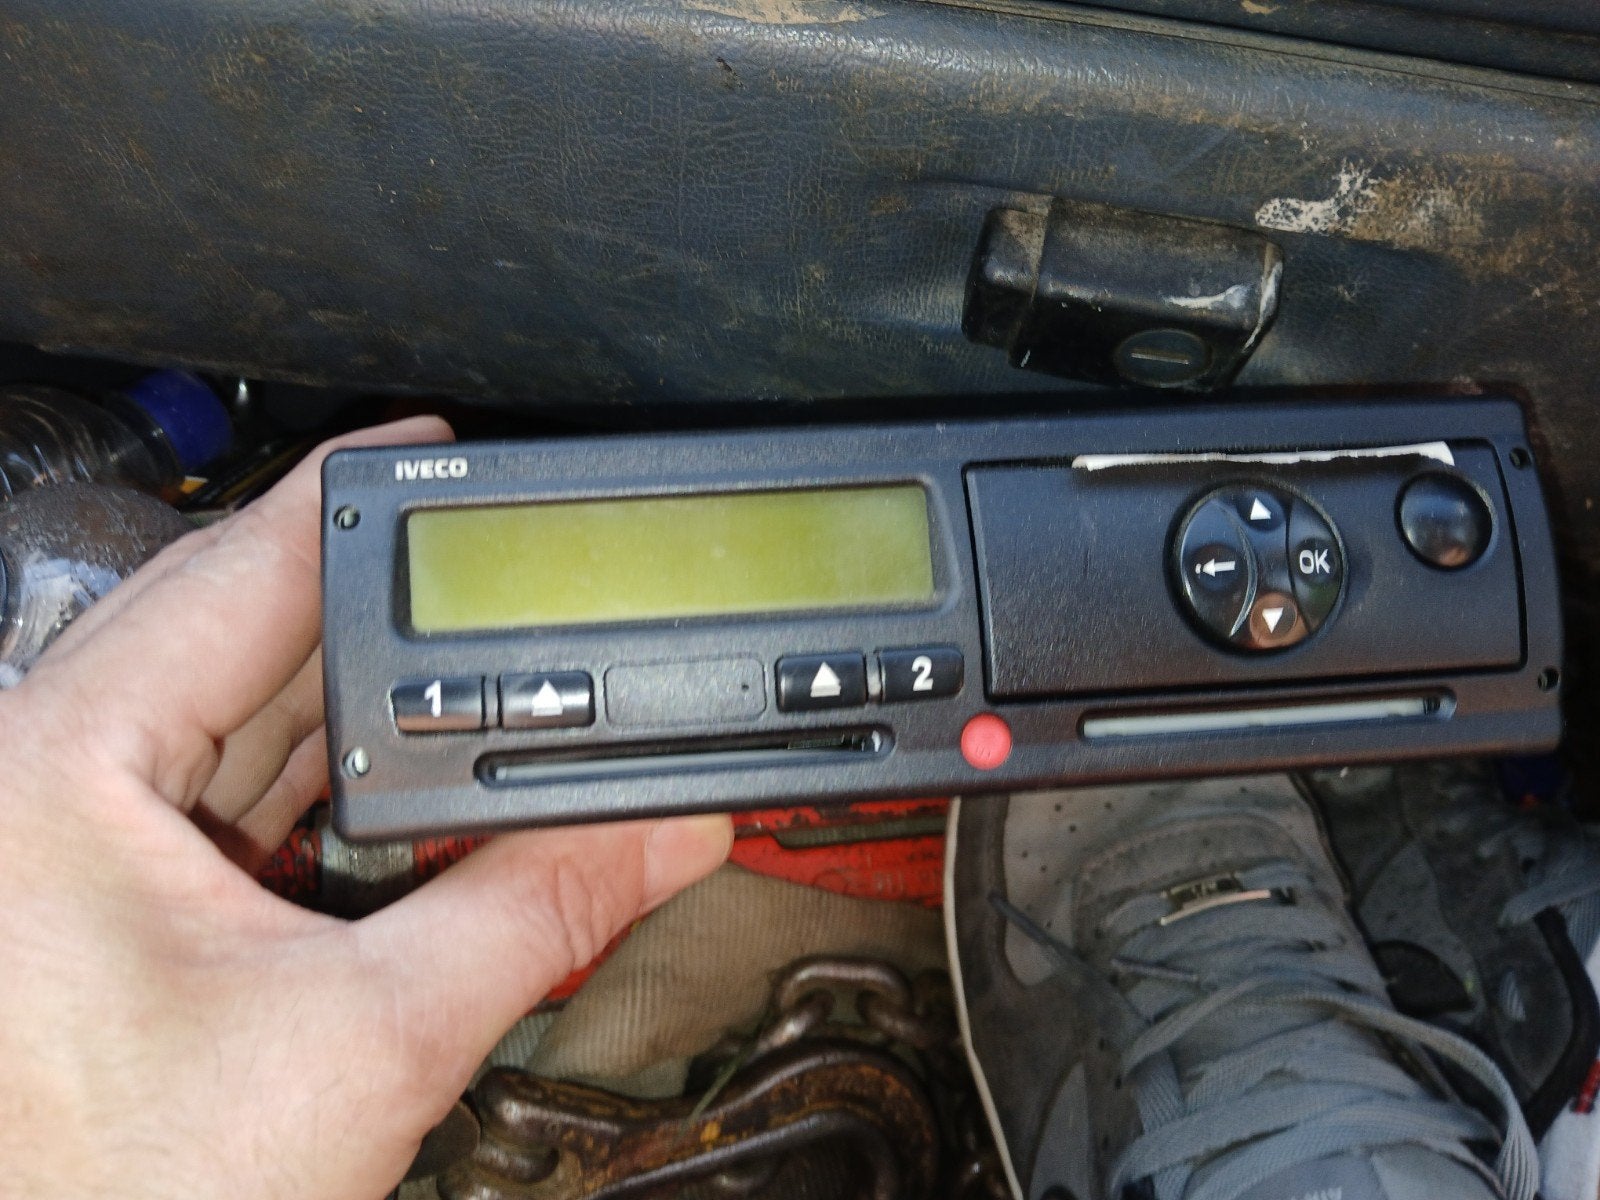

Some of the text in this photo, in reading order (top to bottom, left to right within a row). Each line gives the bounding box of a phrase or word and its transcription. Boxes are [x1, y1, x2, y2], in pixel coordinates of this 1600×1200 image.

[395, 457, 468, 480] IVECO
[1299, 548, 1331, 575] OK
[911, 656, 934, 692] 2
[424, 680, 442, 718] 1
